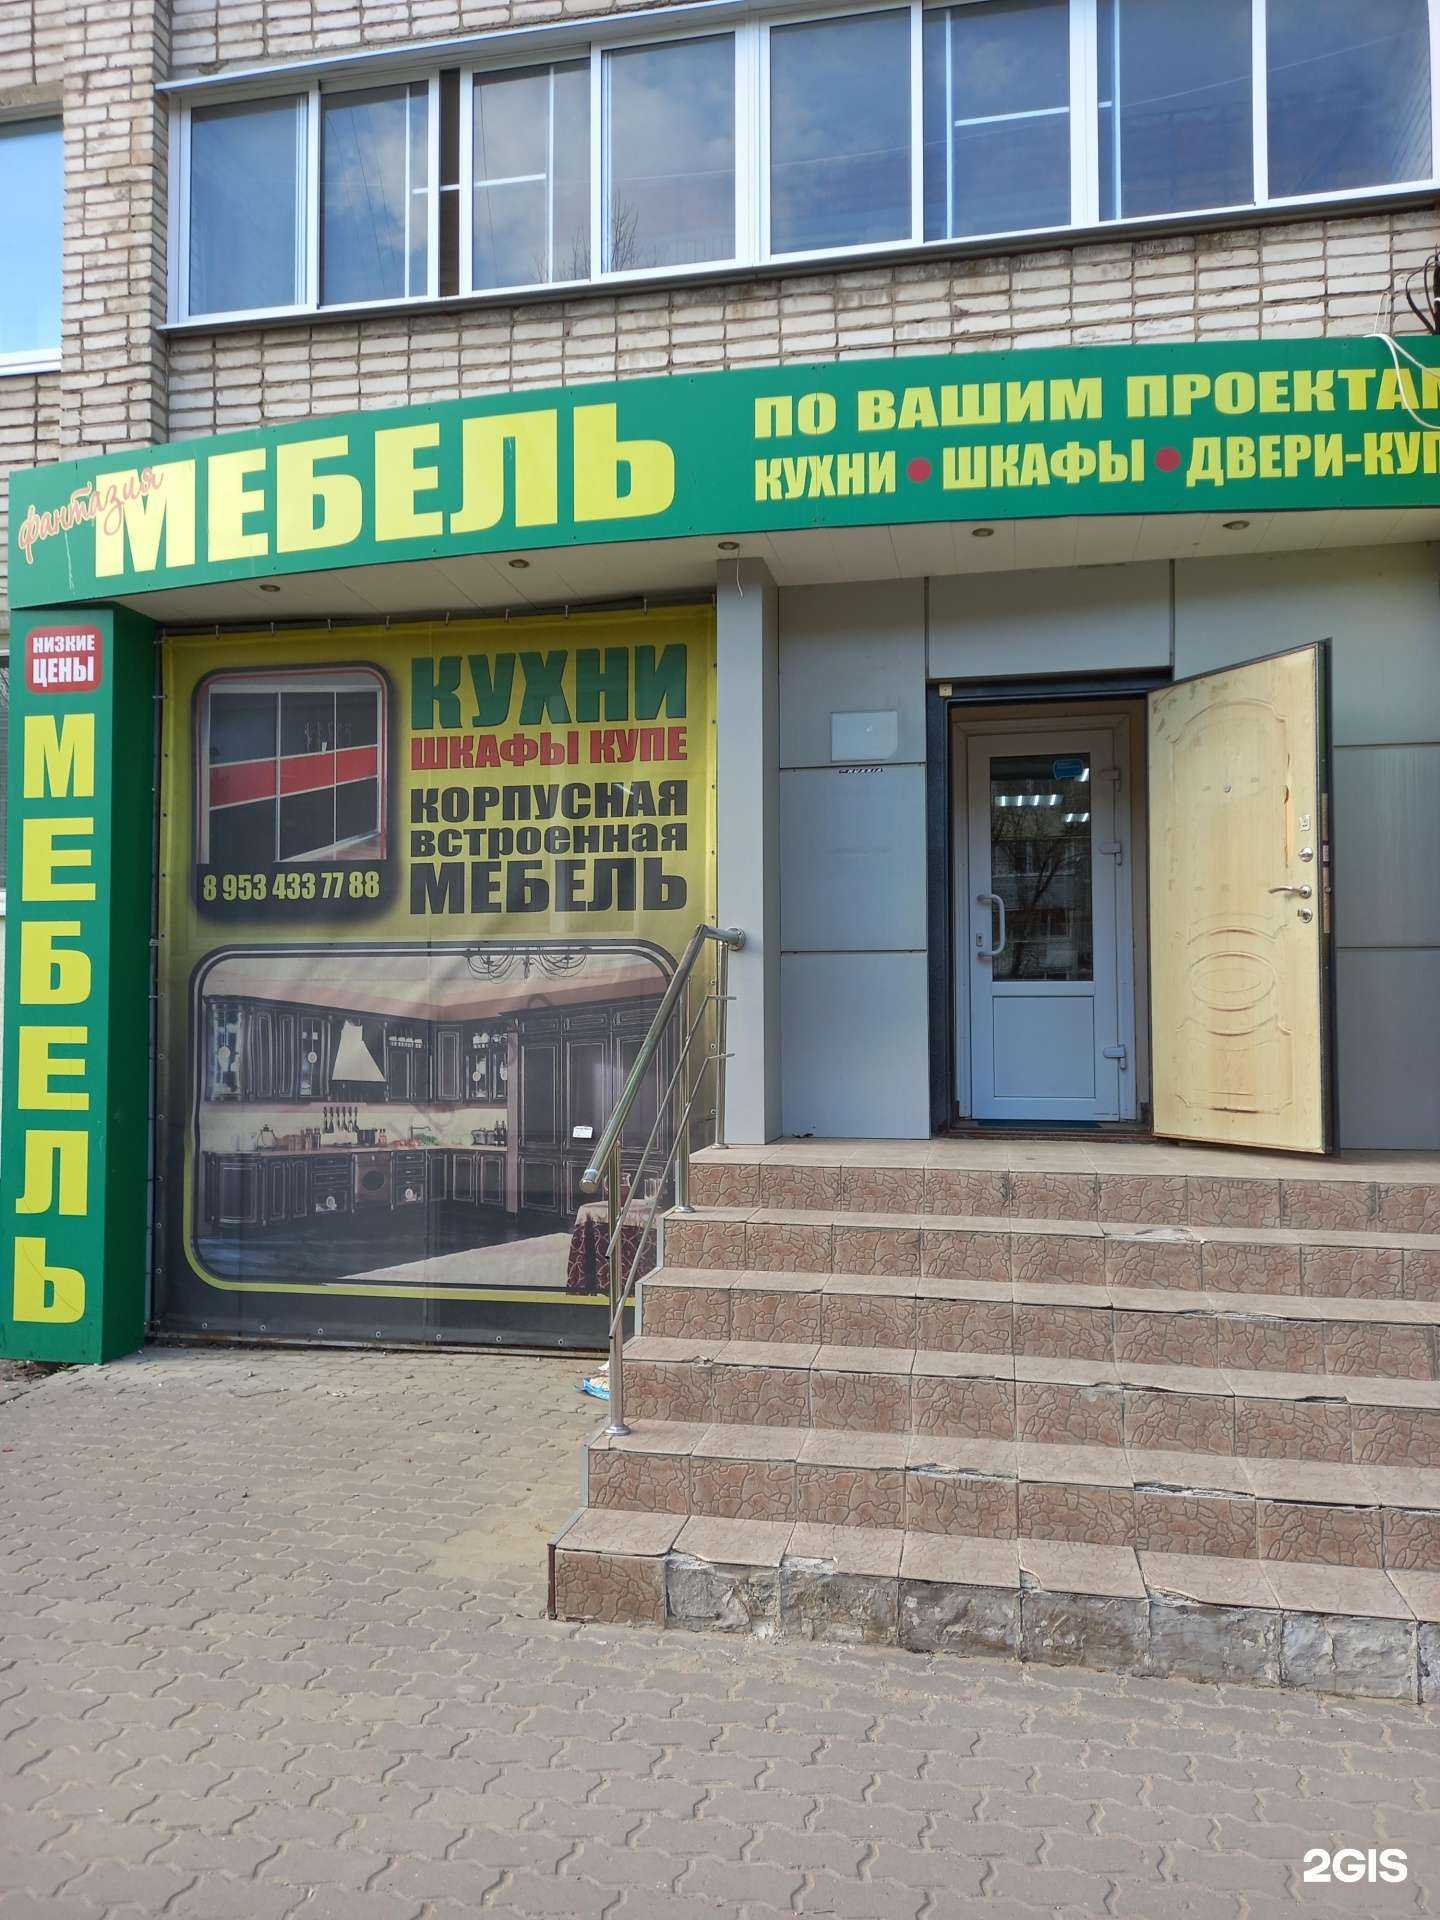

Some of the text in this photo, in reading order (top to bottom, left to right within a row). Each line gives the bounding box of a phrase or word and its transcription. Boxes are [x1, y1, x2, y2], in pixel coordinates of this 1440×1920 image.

[754, 391, 837, 439] ПО
[857, 376, 1103, 432] ВАШИМ
[95, 402, 675, 578] МЕБЕЛЬ
[754, 450, 897, 501] КУХНИ
[942, 438, 1145, 490] ШКАФЫ
[32, 634, 96, 654] НИЗКИЕ
[32, 656, 95, 687] ЦЕНЫ
[410, 643, 688, 730] КУХНИ
[410, 726, 688, 770] ШКАФЫ КУПЕ
[410, 779, 688, 823] КОРПУСНАЯ
[203, 870, 380, 901] 8 953 433 77 88
[410, 857, 688, 914] МЕБЕЛЬ
[13, 713, 96, 1324] МЕБЕЛЬ
